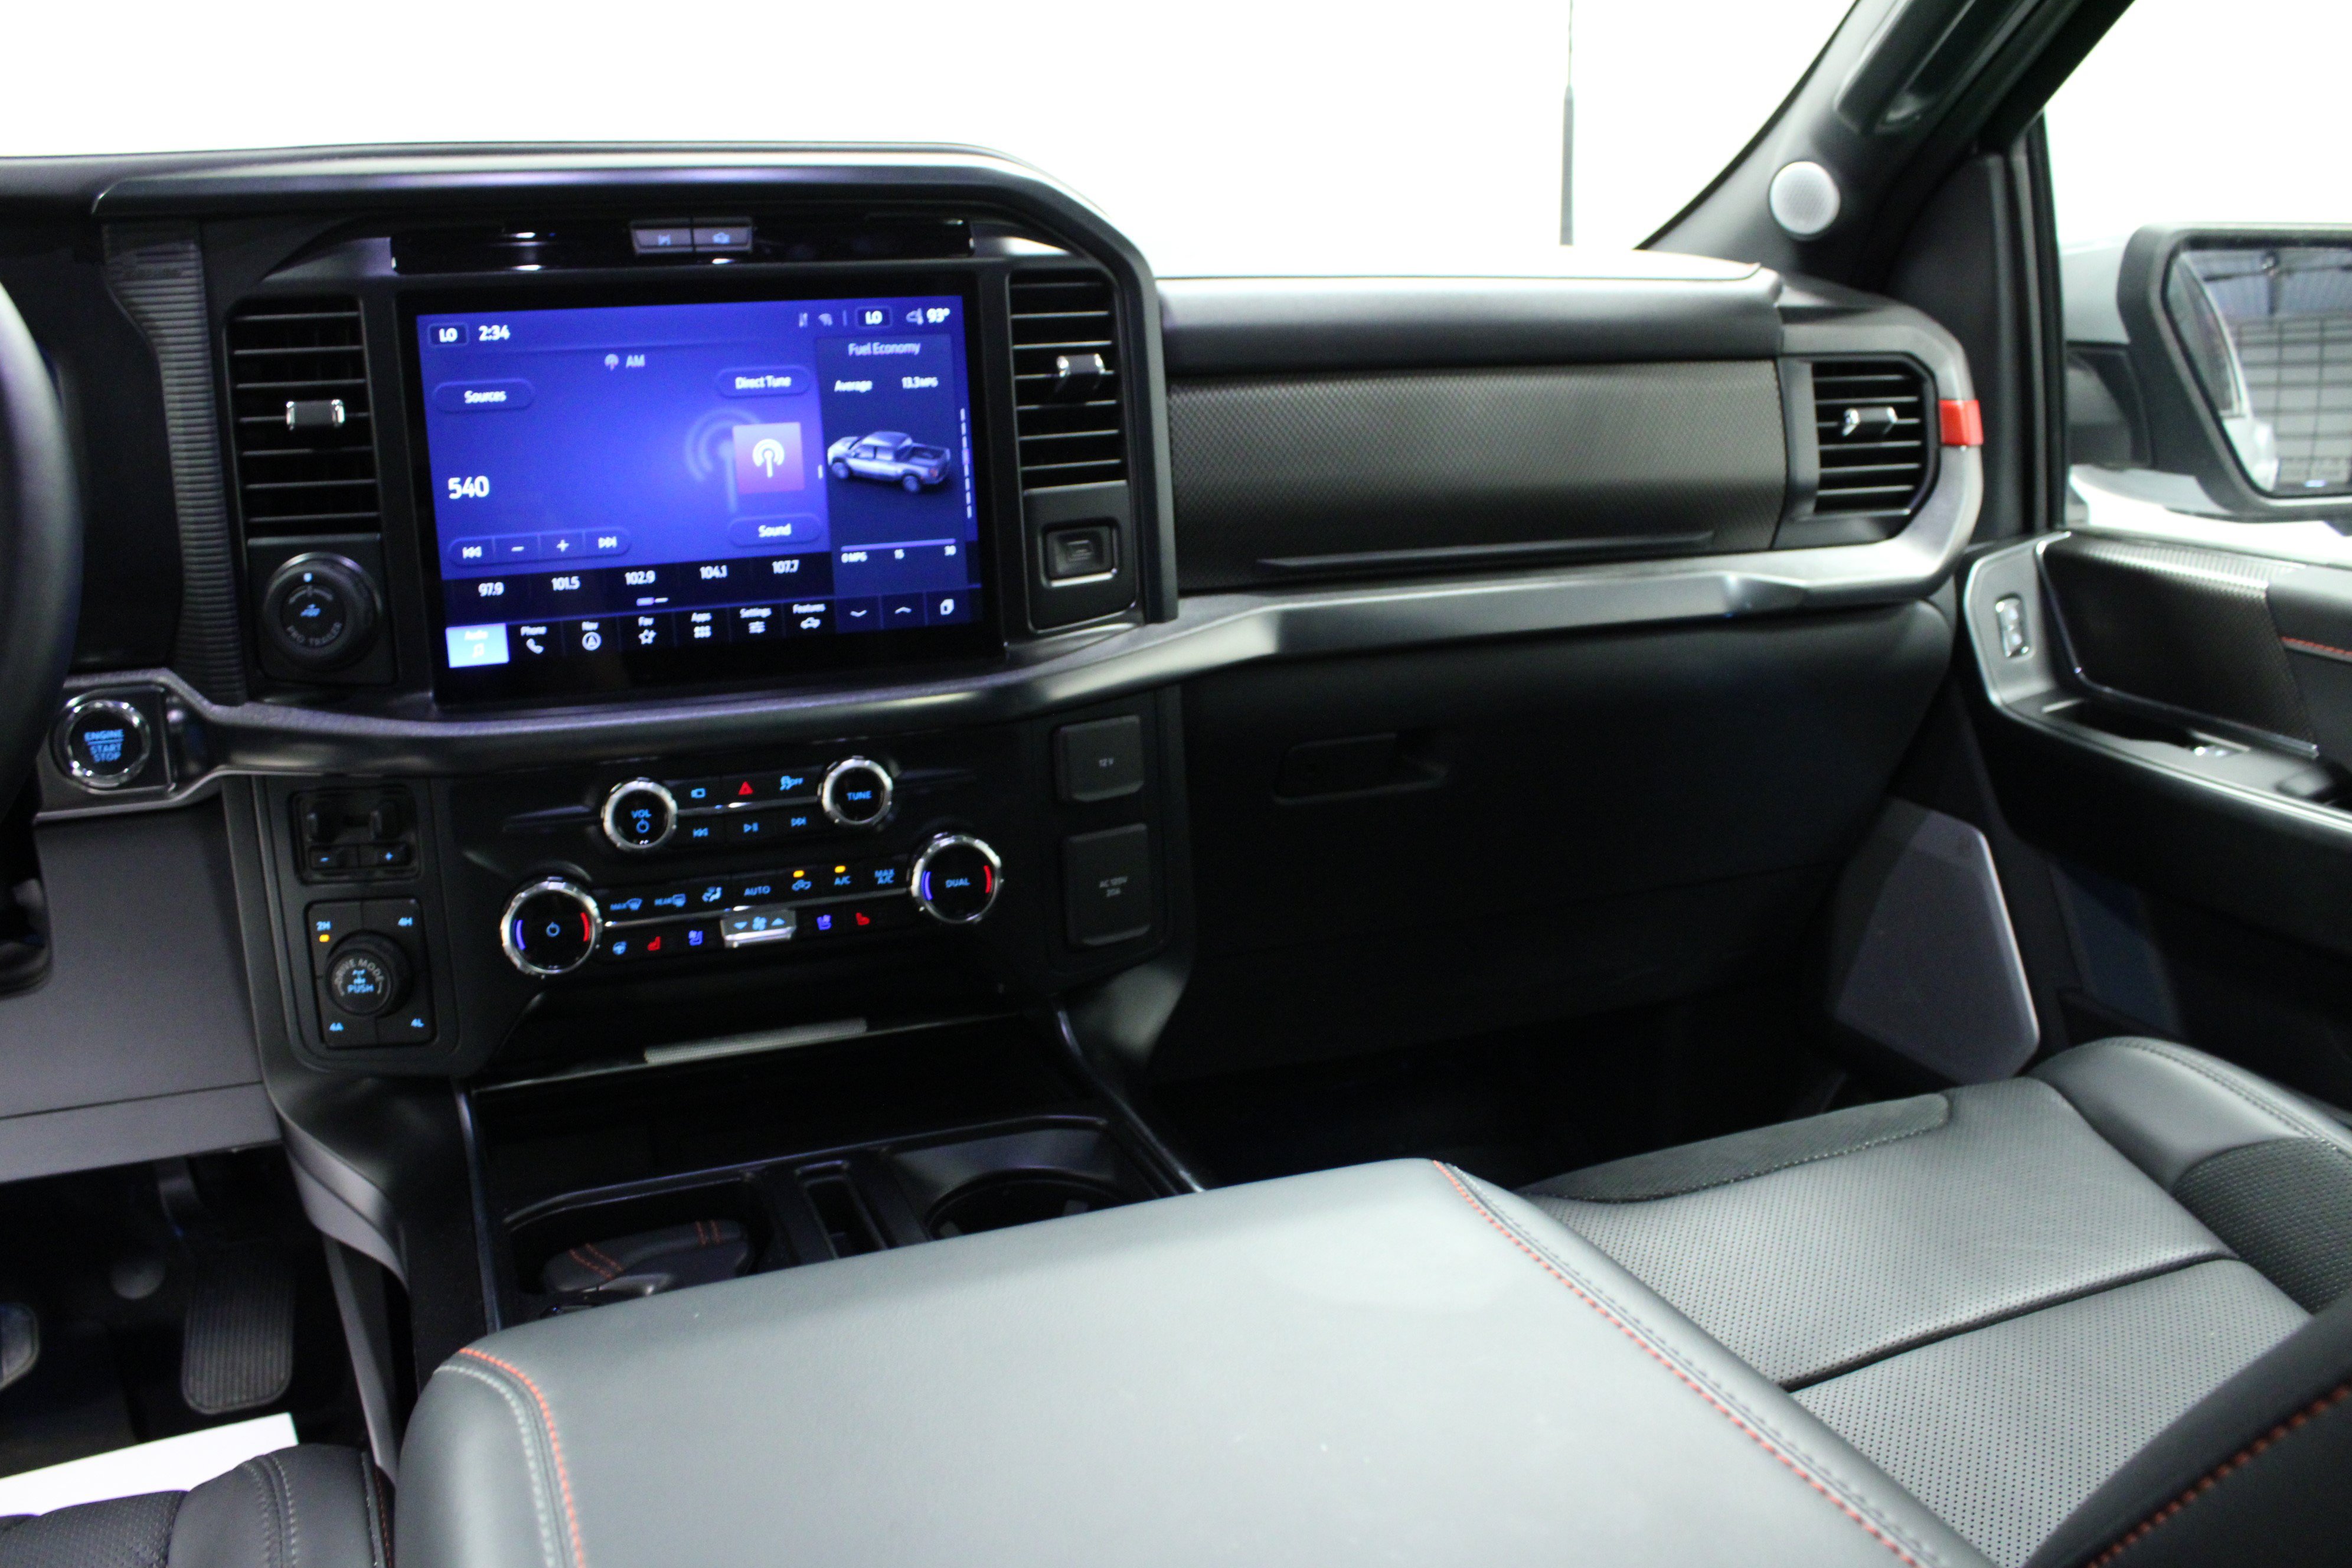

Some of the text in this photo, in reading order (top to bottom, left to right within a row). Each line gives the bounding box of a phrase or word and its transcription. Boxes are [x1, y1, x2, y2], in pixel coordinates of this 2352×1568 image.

[865, 310, 883, 325] LO
[439, 327, 458, 343] LO
[478, 324, 511, 341] 2:34
[848, 342, 921, 355] Fuel Economy
[625, 354, 645, 368] AM
[735, 375, 791, 390] Direct Tune
[834, 380, 873, 393] Average
[464, 390, 507, 404] Sources
[447, 475, 490, 499] 540
[758, 523, 792, 538] Sound
[700, 564, 727, 580] 104.1
[772, 559, 799, 574] 107.7
[551, 576, 580, 591] 101.5
[625, 570, 656, 585] 102.9
[478, 582, 504, 597] 97.9
[91, 743, 122, 754] START
[94, 752, 122, 762] STOP
[847, 790, 871, 801] TUNE
[631, 809, 652, 819] VOL
[874, 868, 894, 878] MAX
[877, 876, 894, 884] A/C
[834, 876, 851, 886] A/C
[945, 877, 970, 888] DUAL
[743, 885, 770, 896] AUTO
[316, 921, 331, 931] 2H
[357, 958, 384, 982] MODE
[347, 984, 374, 993] PUSH
